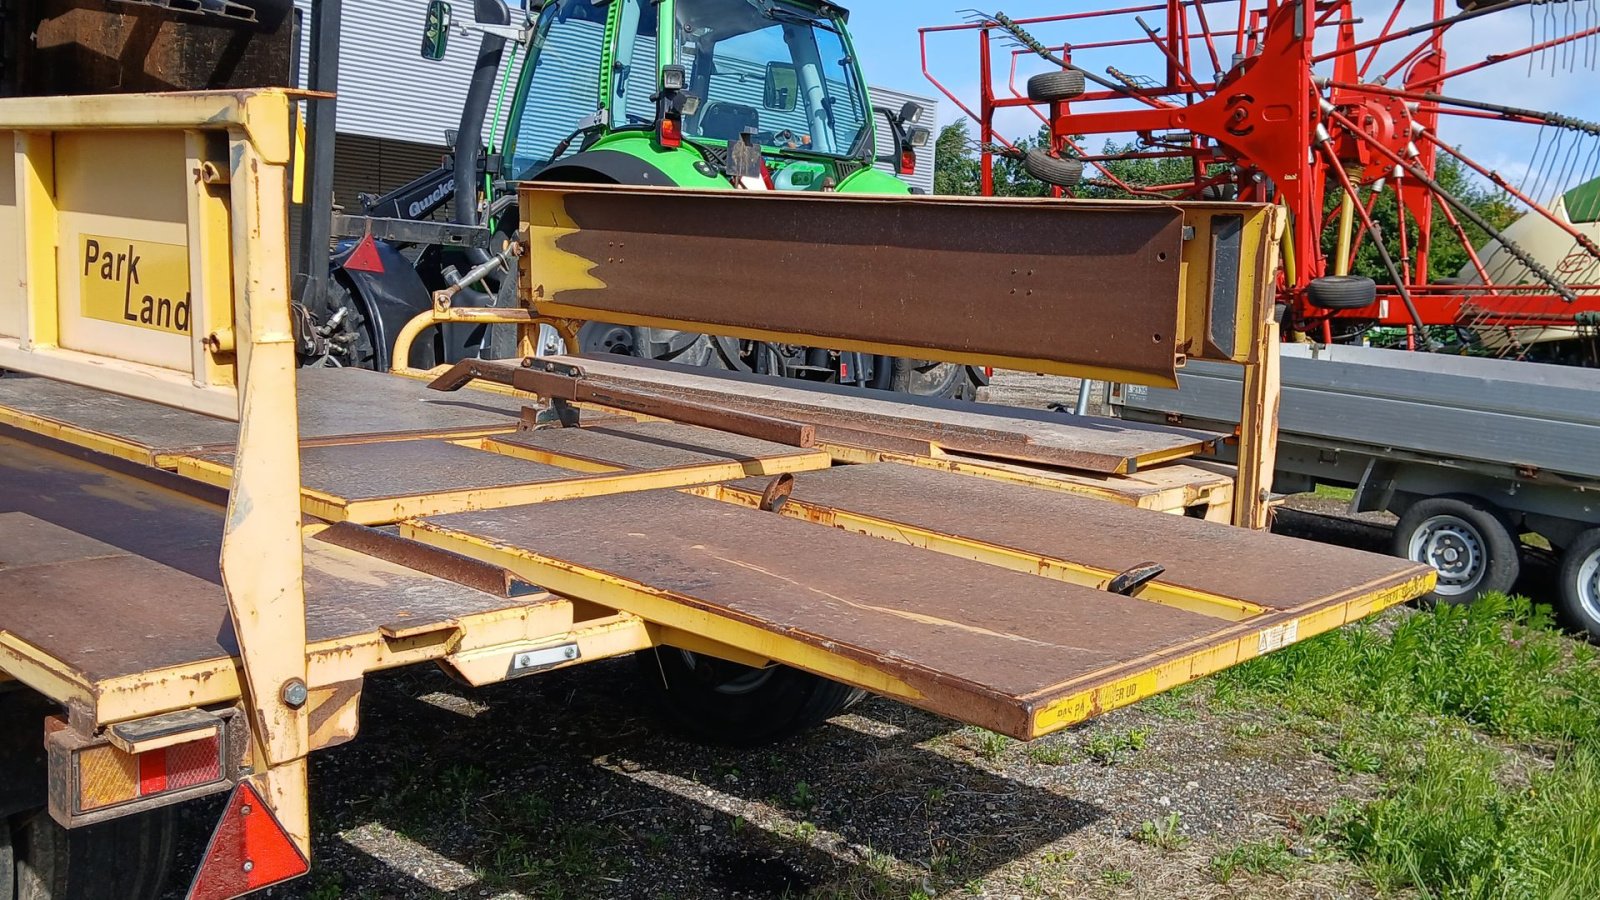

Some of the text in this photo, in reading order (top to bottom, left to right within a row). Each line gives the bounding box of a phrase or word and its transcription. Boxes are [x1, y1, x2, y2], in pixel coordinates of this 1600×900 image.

[409, 179, 455, 217] Quicke
[84, 238, 141, 285] Park
[124, 283, 191, 332] Land
